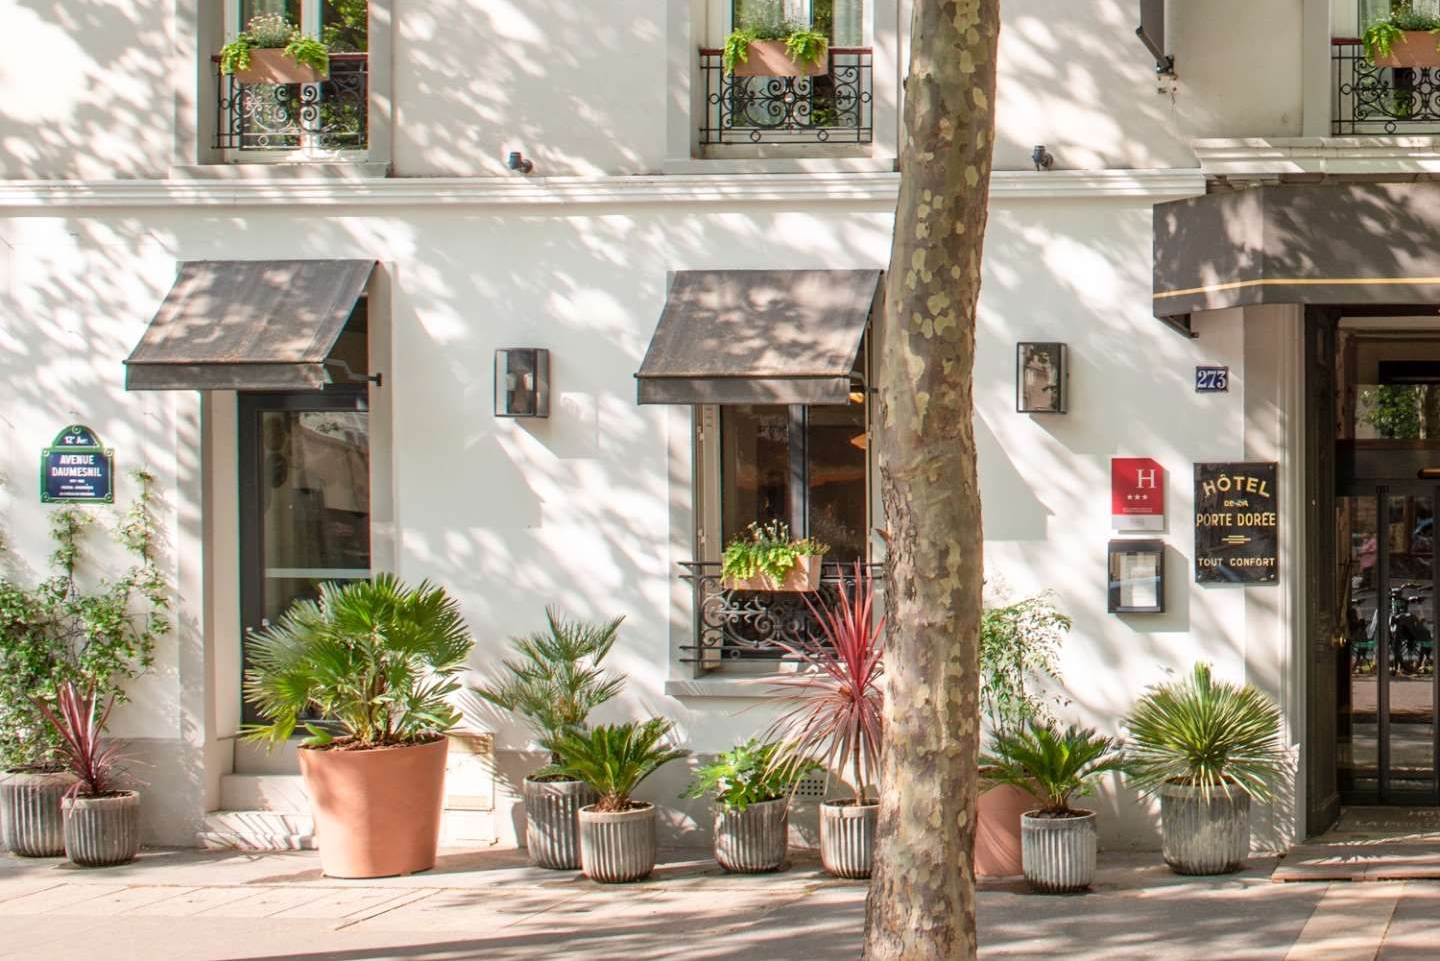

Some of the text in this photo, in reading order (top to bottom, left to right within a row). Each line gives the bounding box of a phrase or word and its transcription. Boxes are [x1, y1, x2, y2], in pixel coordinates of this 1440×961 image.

[1198, 370, 1226, 389] 273
[60, 455, 94, 464] AVENUE
[51, 467, 102, 477] DAUMESNIL
[1136, 469, 1157, 489] H
[1202, 473, 1270, 498] HÔTEL
[1196, 511, 1276, 527] PORTE DORÉE
[1198, 557, 1275, 567] TOUT CONFORT
